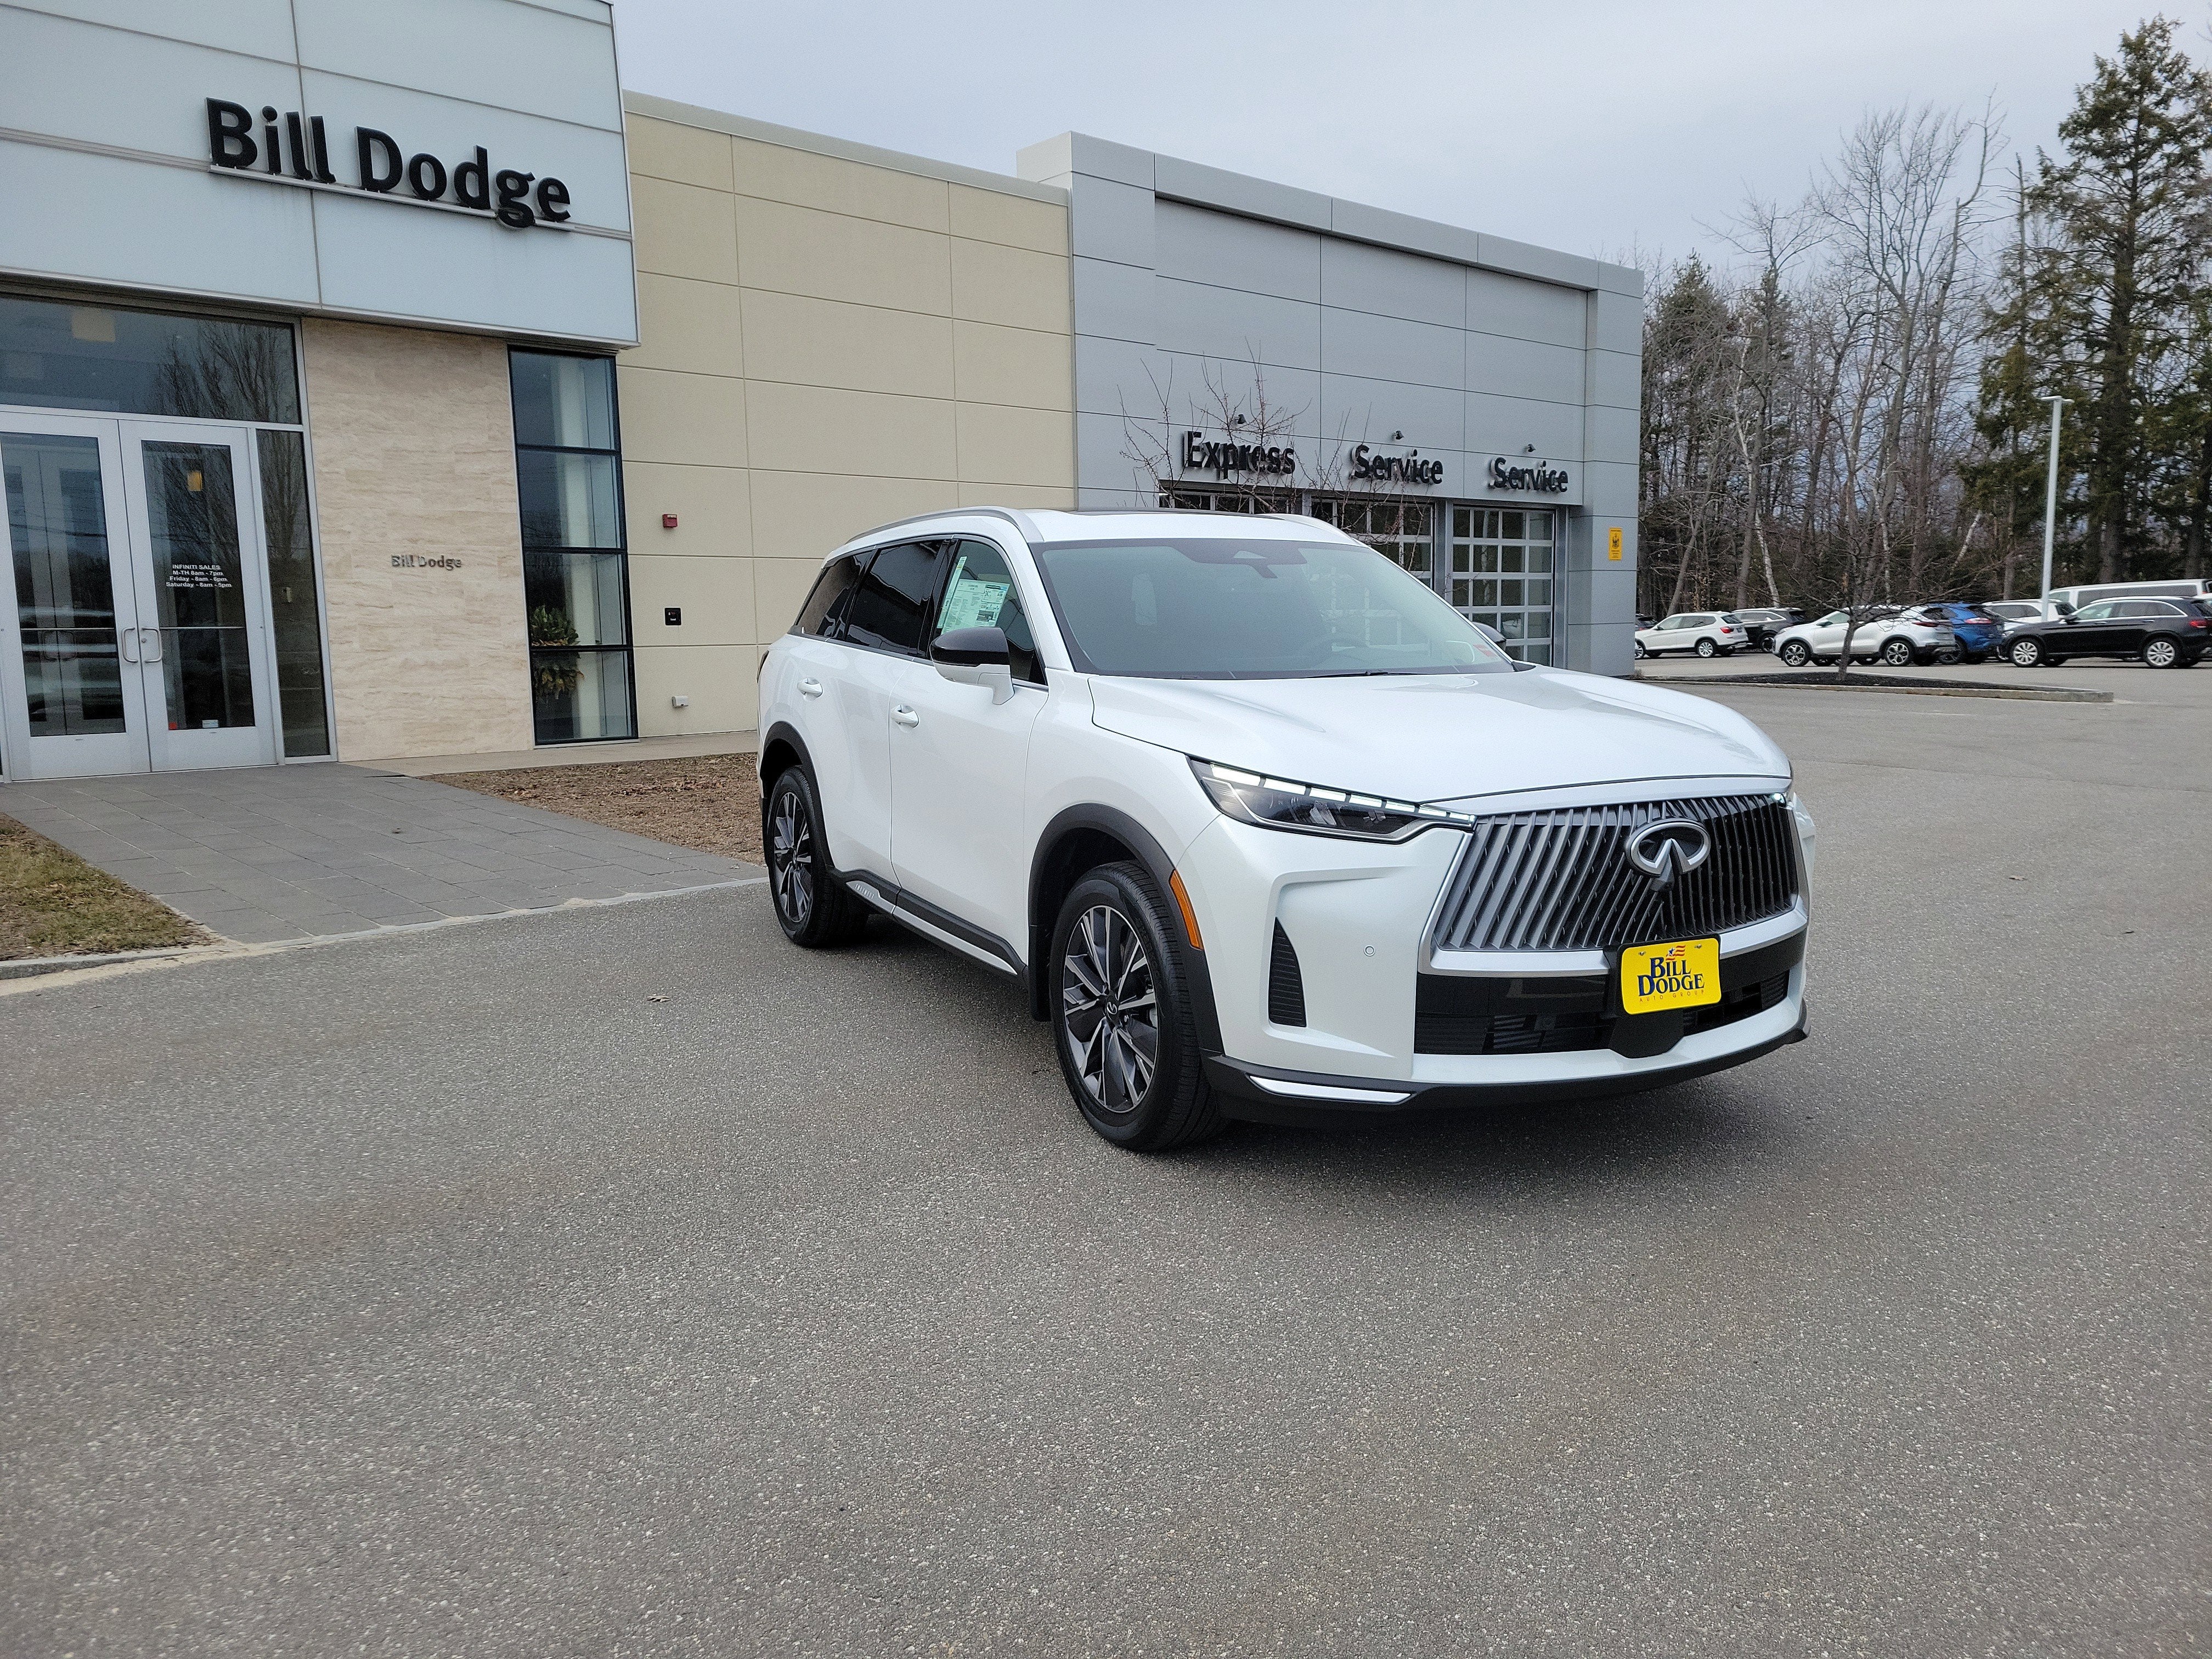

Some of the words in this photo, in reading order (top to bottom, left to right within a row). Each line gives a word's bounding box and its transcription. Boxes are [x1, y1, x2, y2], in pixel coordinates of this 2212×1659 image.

[206, 97, 336, 184] Bill
[354, 126, 571, 228] Dodge
[1184, 431, 1296, 480] Express
[1351, 444, 1443, 484] Service
[1488, 457, 1568, 493] Service
[391, 554, 415, 567] Bill
[417, 554, 462, 571] Dodge
[1650, 957, 1692, 978] BILL
[1637, 973, 1705, 996] DODGE
[1673, 990, 1704, 998] GROUP
